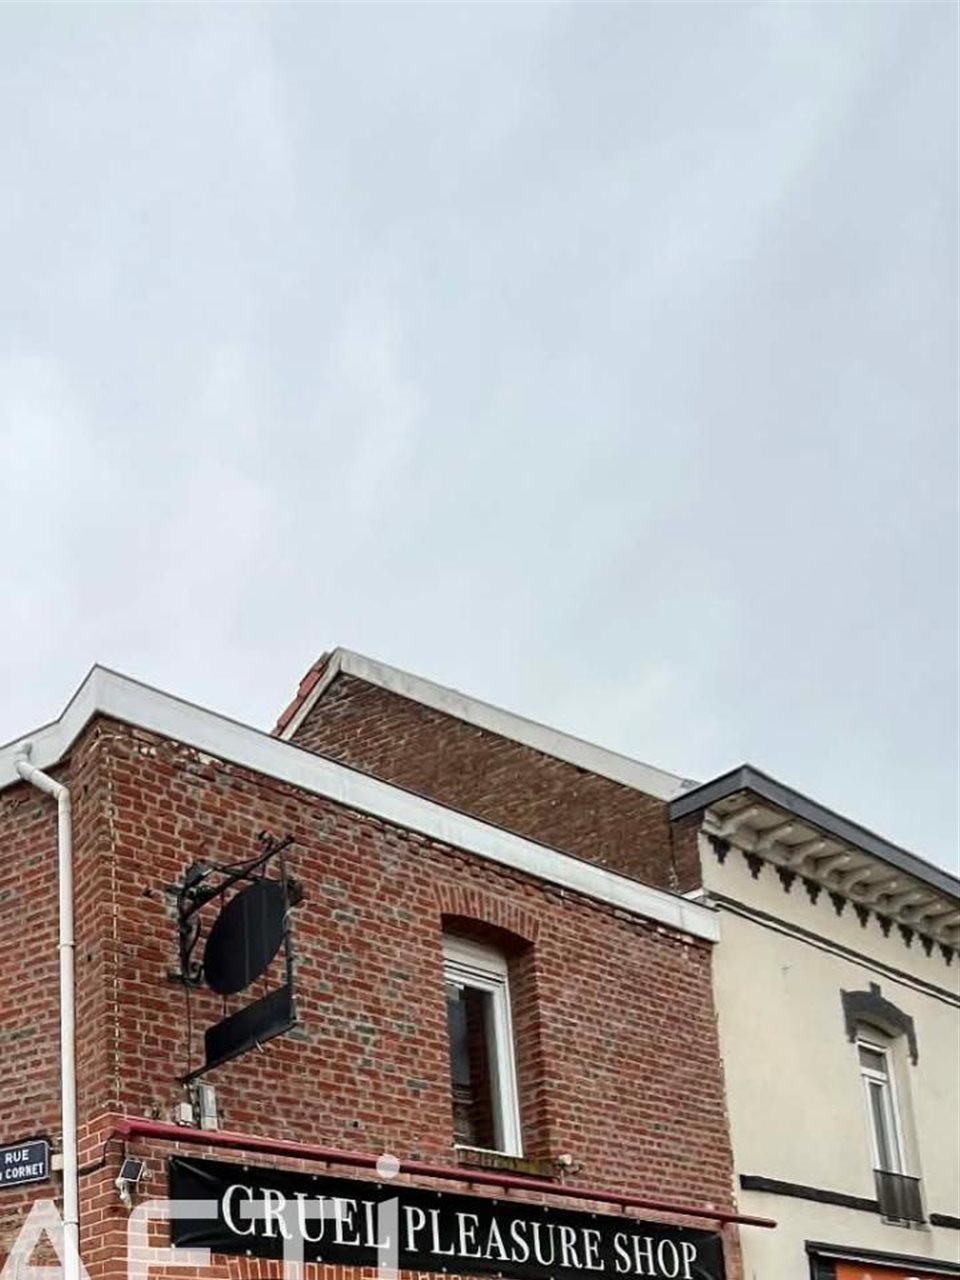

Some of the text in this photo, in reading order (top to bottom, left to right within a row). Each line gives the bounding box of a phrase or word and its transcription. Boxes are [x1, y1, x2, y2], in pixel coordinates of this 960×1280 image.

[5, 1149, 29, 1164] RUE
[5, 1162, 44, 1179] CORNET
[222, 1184, 697, 1280] CRUEL PLEASURE SHOP
